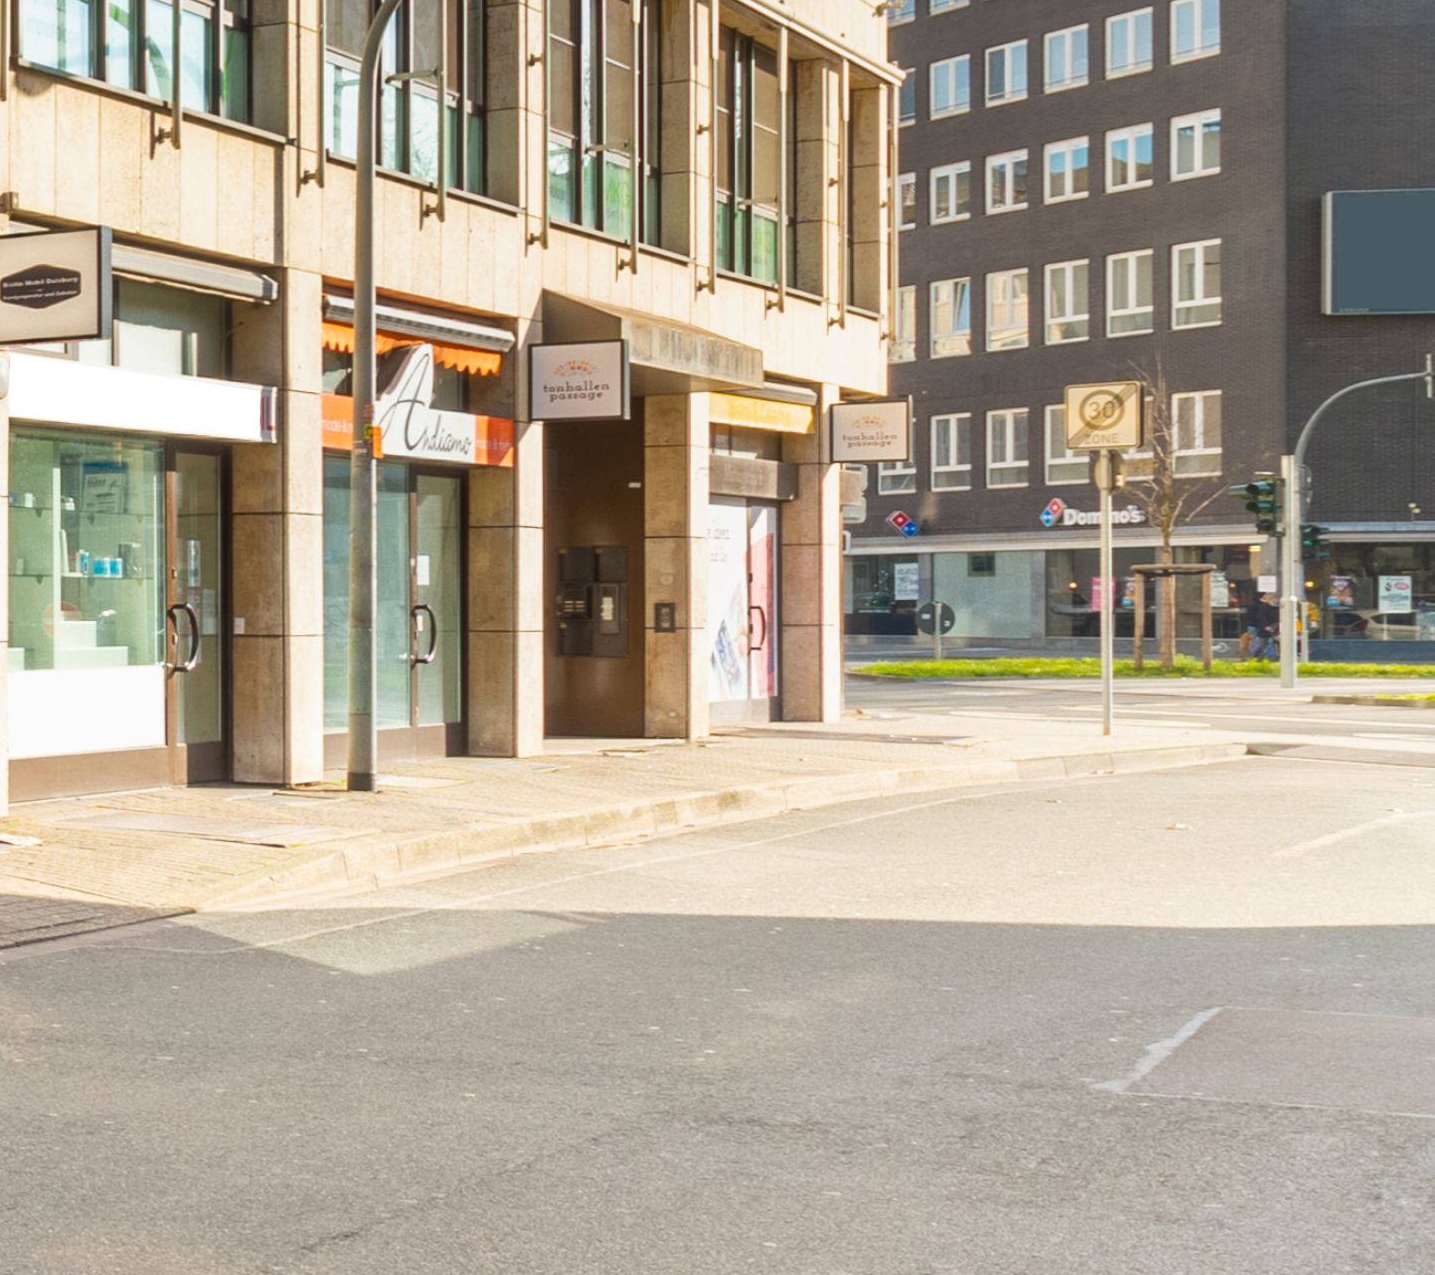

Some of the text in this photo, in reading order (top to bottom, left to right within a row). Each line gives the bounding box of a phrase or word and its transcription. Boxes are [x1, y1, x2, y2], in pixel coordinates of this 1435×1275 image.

[542, 380, 610, 393] tonhallen
[549, 391, 603, 402] passage
[1088, 400, 1116, 421] 30
[842, 431, 898, 441] tonhallen
[1083, 432, 1120, 445] ZONE
[847, 440, 892, 449] passage
[1063, 505, 1141, 526] Domno's
